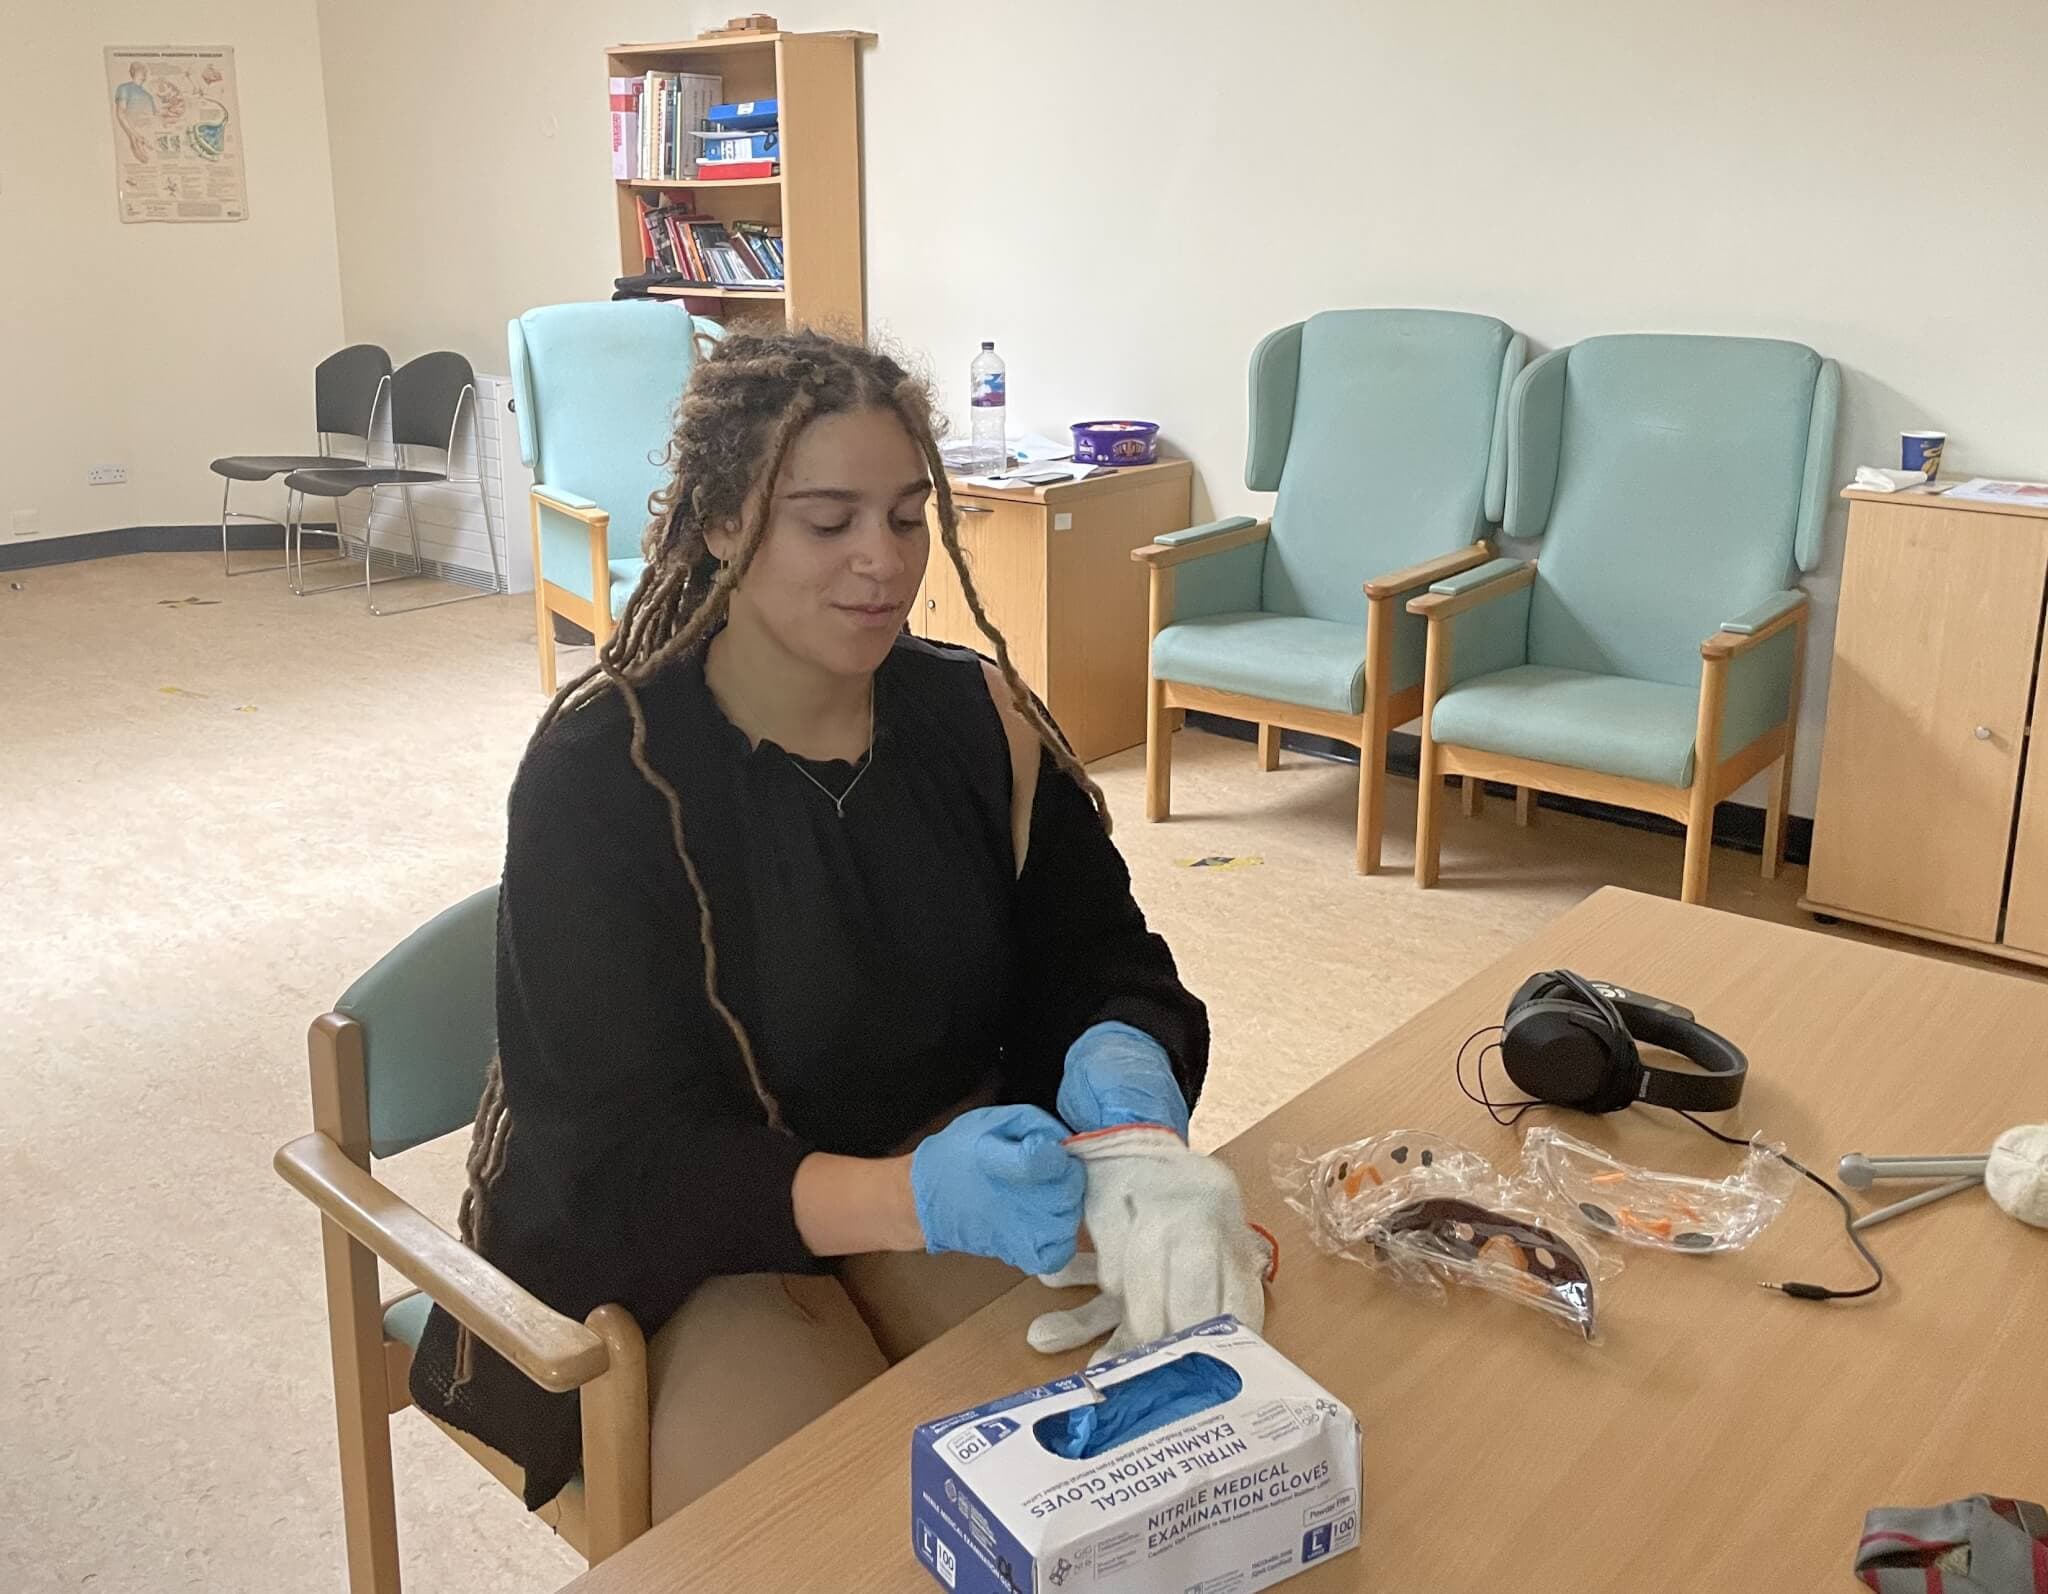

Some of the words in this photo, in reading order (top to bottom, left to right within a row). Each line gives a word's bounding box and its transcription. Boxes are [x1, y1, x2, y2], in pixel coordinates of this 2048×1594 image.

[959, 1438, 987, 1460] 100
[1109, 1423, 1235, 1485] EXAMINATION
[1177, 1438, 1248, 1473] NITRILE
[1030, 1478, 1106, 1518] GLOVES
[1090, 1467, 1177, 1511] MEDICAL
[1148, 1489, 1207, 1531] NITRILE
[1213, 1462, 1289, 1499] MEDICAL
[1148, 1489, 1263, 1549] EXAMINATION
[1269, 1460, 1328, 1497] GLOVES
[1310, 1502, 1335, 1519] Powder
[1334, 1516, 1355, 1537] 100
[924, 1532, 932, 1554] L
[938, 1545, 954, 1571] 100
[1312, 1535, 1322, 1551] L
